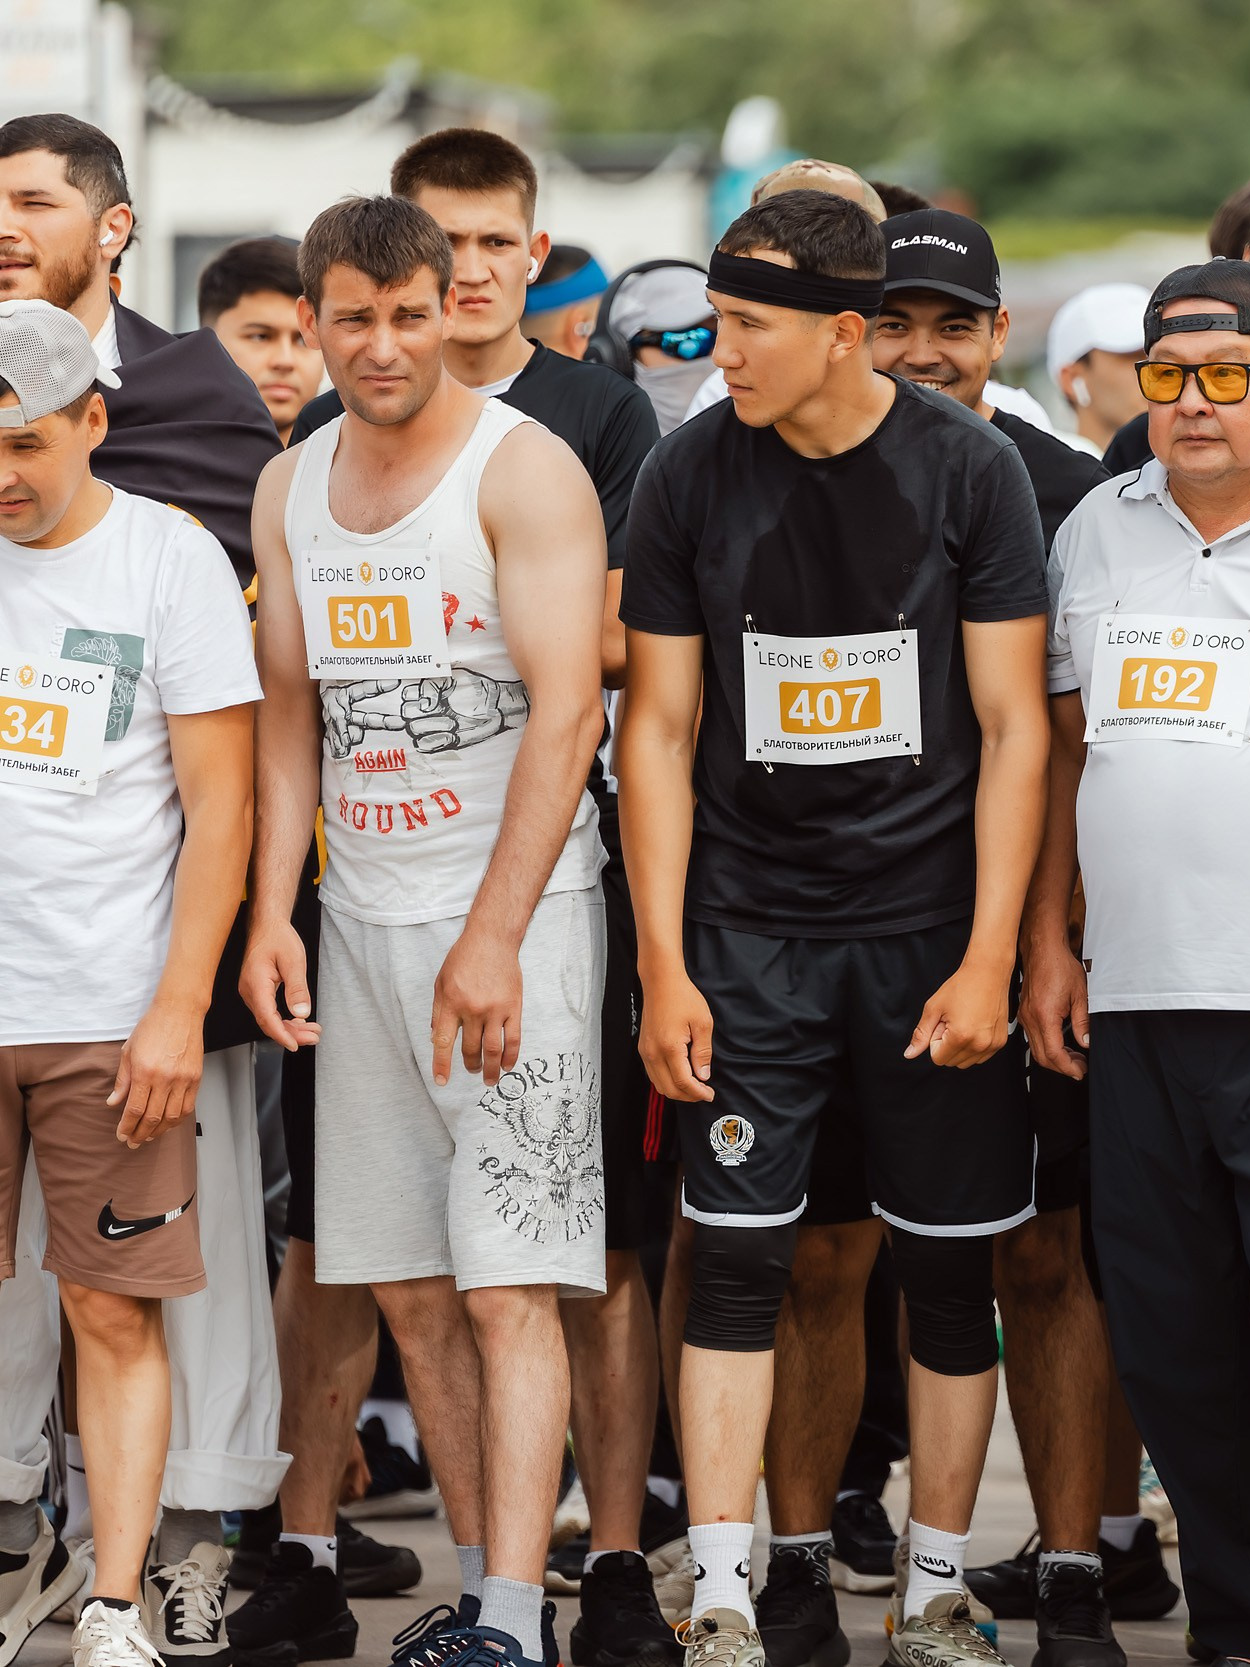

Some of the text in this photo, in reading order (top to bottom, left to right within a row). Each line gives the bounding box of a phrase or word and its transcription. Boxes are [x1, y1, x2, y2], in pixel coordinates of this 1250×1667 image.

[891, 235, 968, 255] GLASMAN
[311, 566, 426, 582] LEONE D'ORO
[337, 602, 397, 642] 501
[1108, 630, 1245, 651] LEONE D'ORO
[319, 654, 433, 665] БЛАГОТВОРИТЕЛЬНЫЙ ЗАБЕГ
[759, 647, 901, 669] LEONE D'ORO
[42, 674, 95, 695] D'ORO
[1130, 663, 1205, 704] 192
[788, 685, 870, 727] 407
[1100, 716, 1227, 730] БЛАГОТВОРИТЕЛЬНЫЙ ЗАБЕГ
[763, 733, 903, 751] БЛАГОТВОРИТЕЛЬНЫЙ ЗАБЕГ
[354, 748, 407, 770] AGAIN
[50, 766, 81, 778] ЗАБЕГ
[339, 788, 463, 834] ROUND
[165, 1206, 182, 1224] NIKE
[483, 1181, 550, 1244] FREE
[905, 1644, 956, 1667] CORDUR
